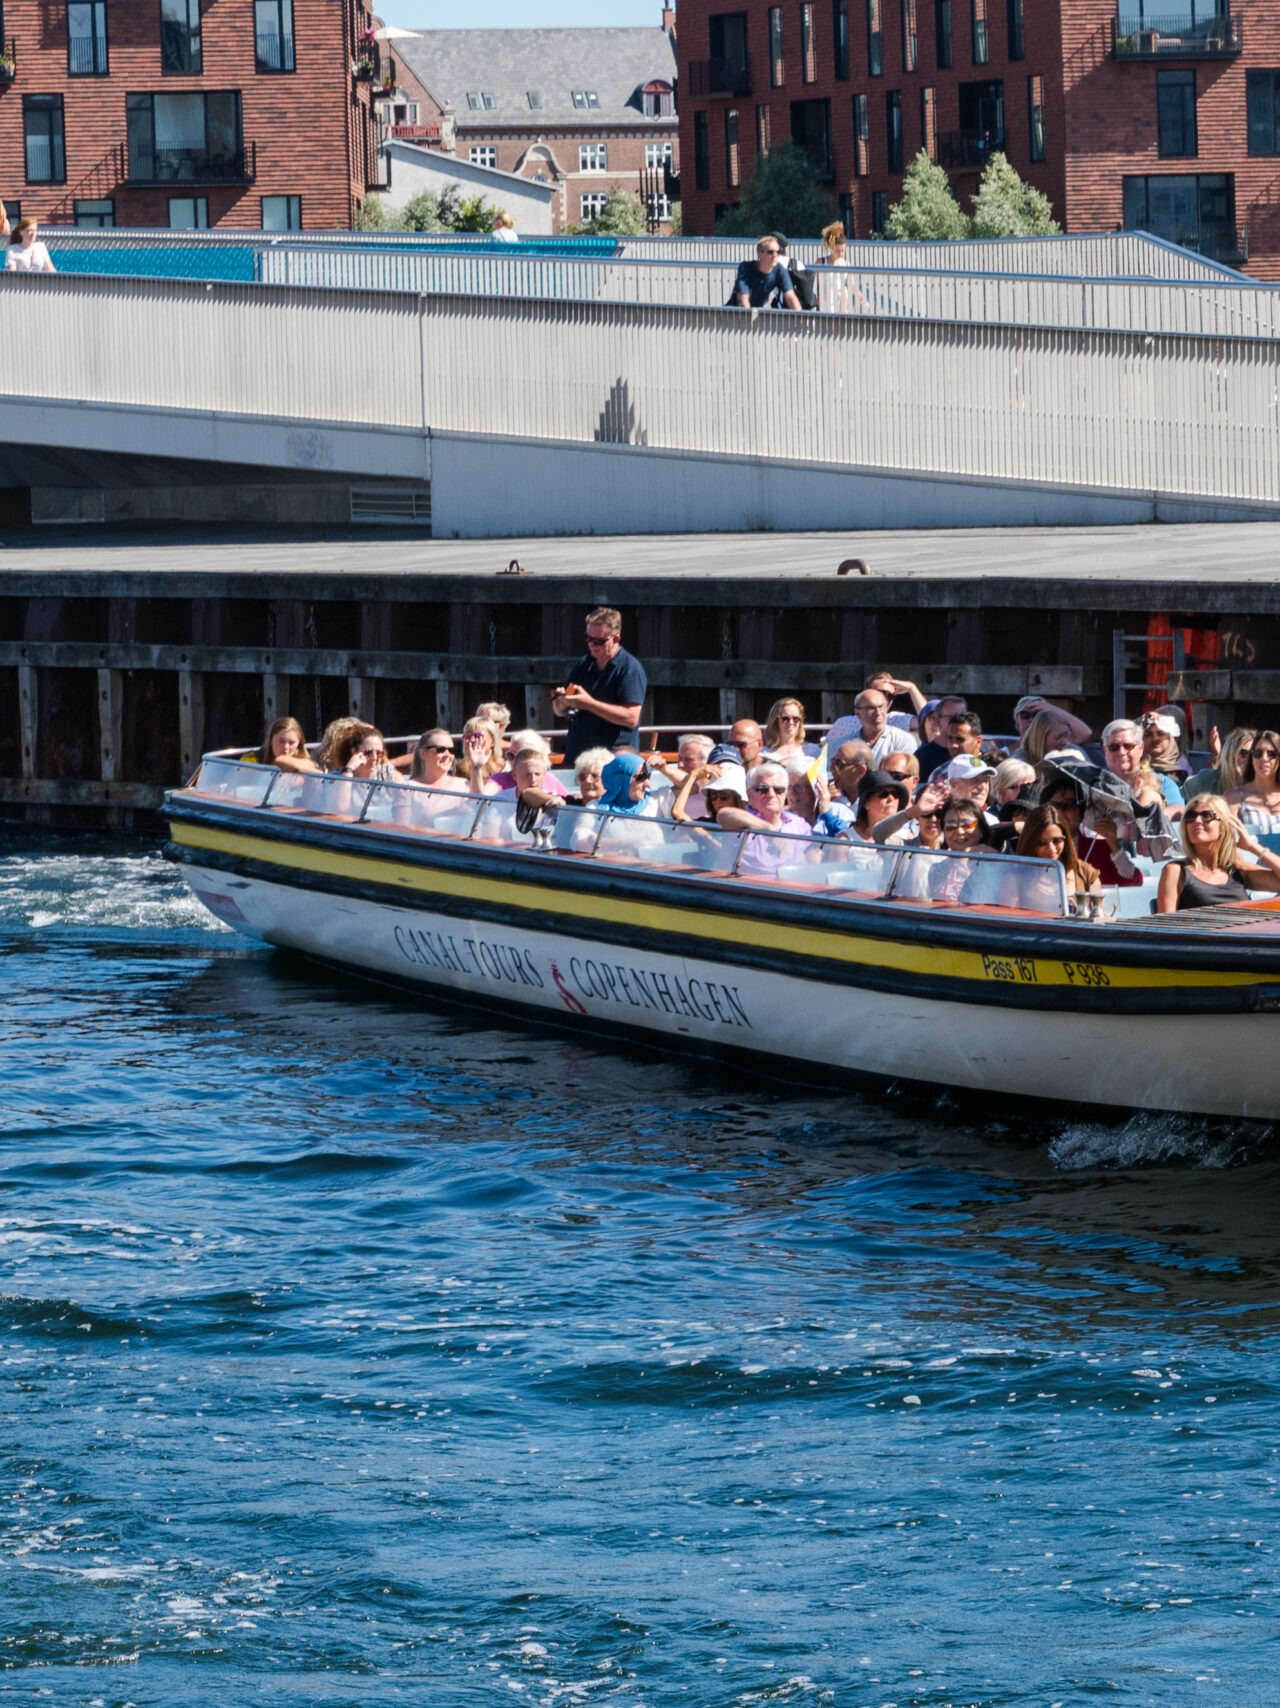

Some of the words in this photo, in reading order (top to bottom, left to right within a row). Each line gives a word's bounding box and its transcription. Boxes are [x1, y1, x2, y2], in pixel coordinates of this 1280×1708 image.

[394, 924, 472, 974] CANAL
[463, 936, 545, 989] TOURS
[981, 954, 1015, 980] Pass
[1014, 957, 1038, 983] 167
[1062, 961, 1075, 985] P
[1076, 963, 1111, 986] 936
[569, 956, 753, 1030] COPENHAGEN
